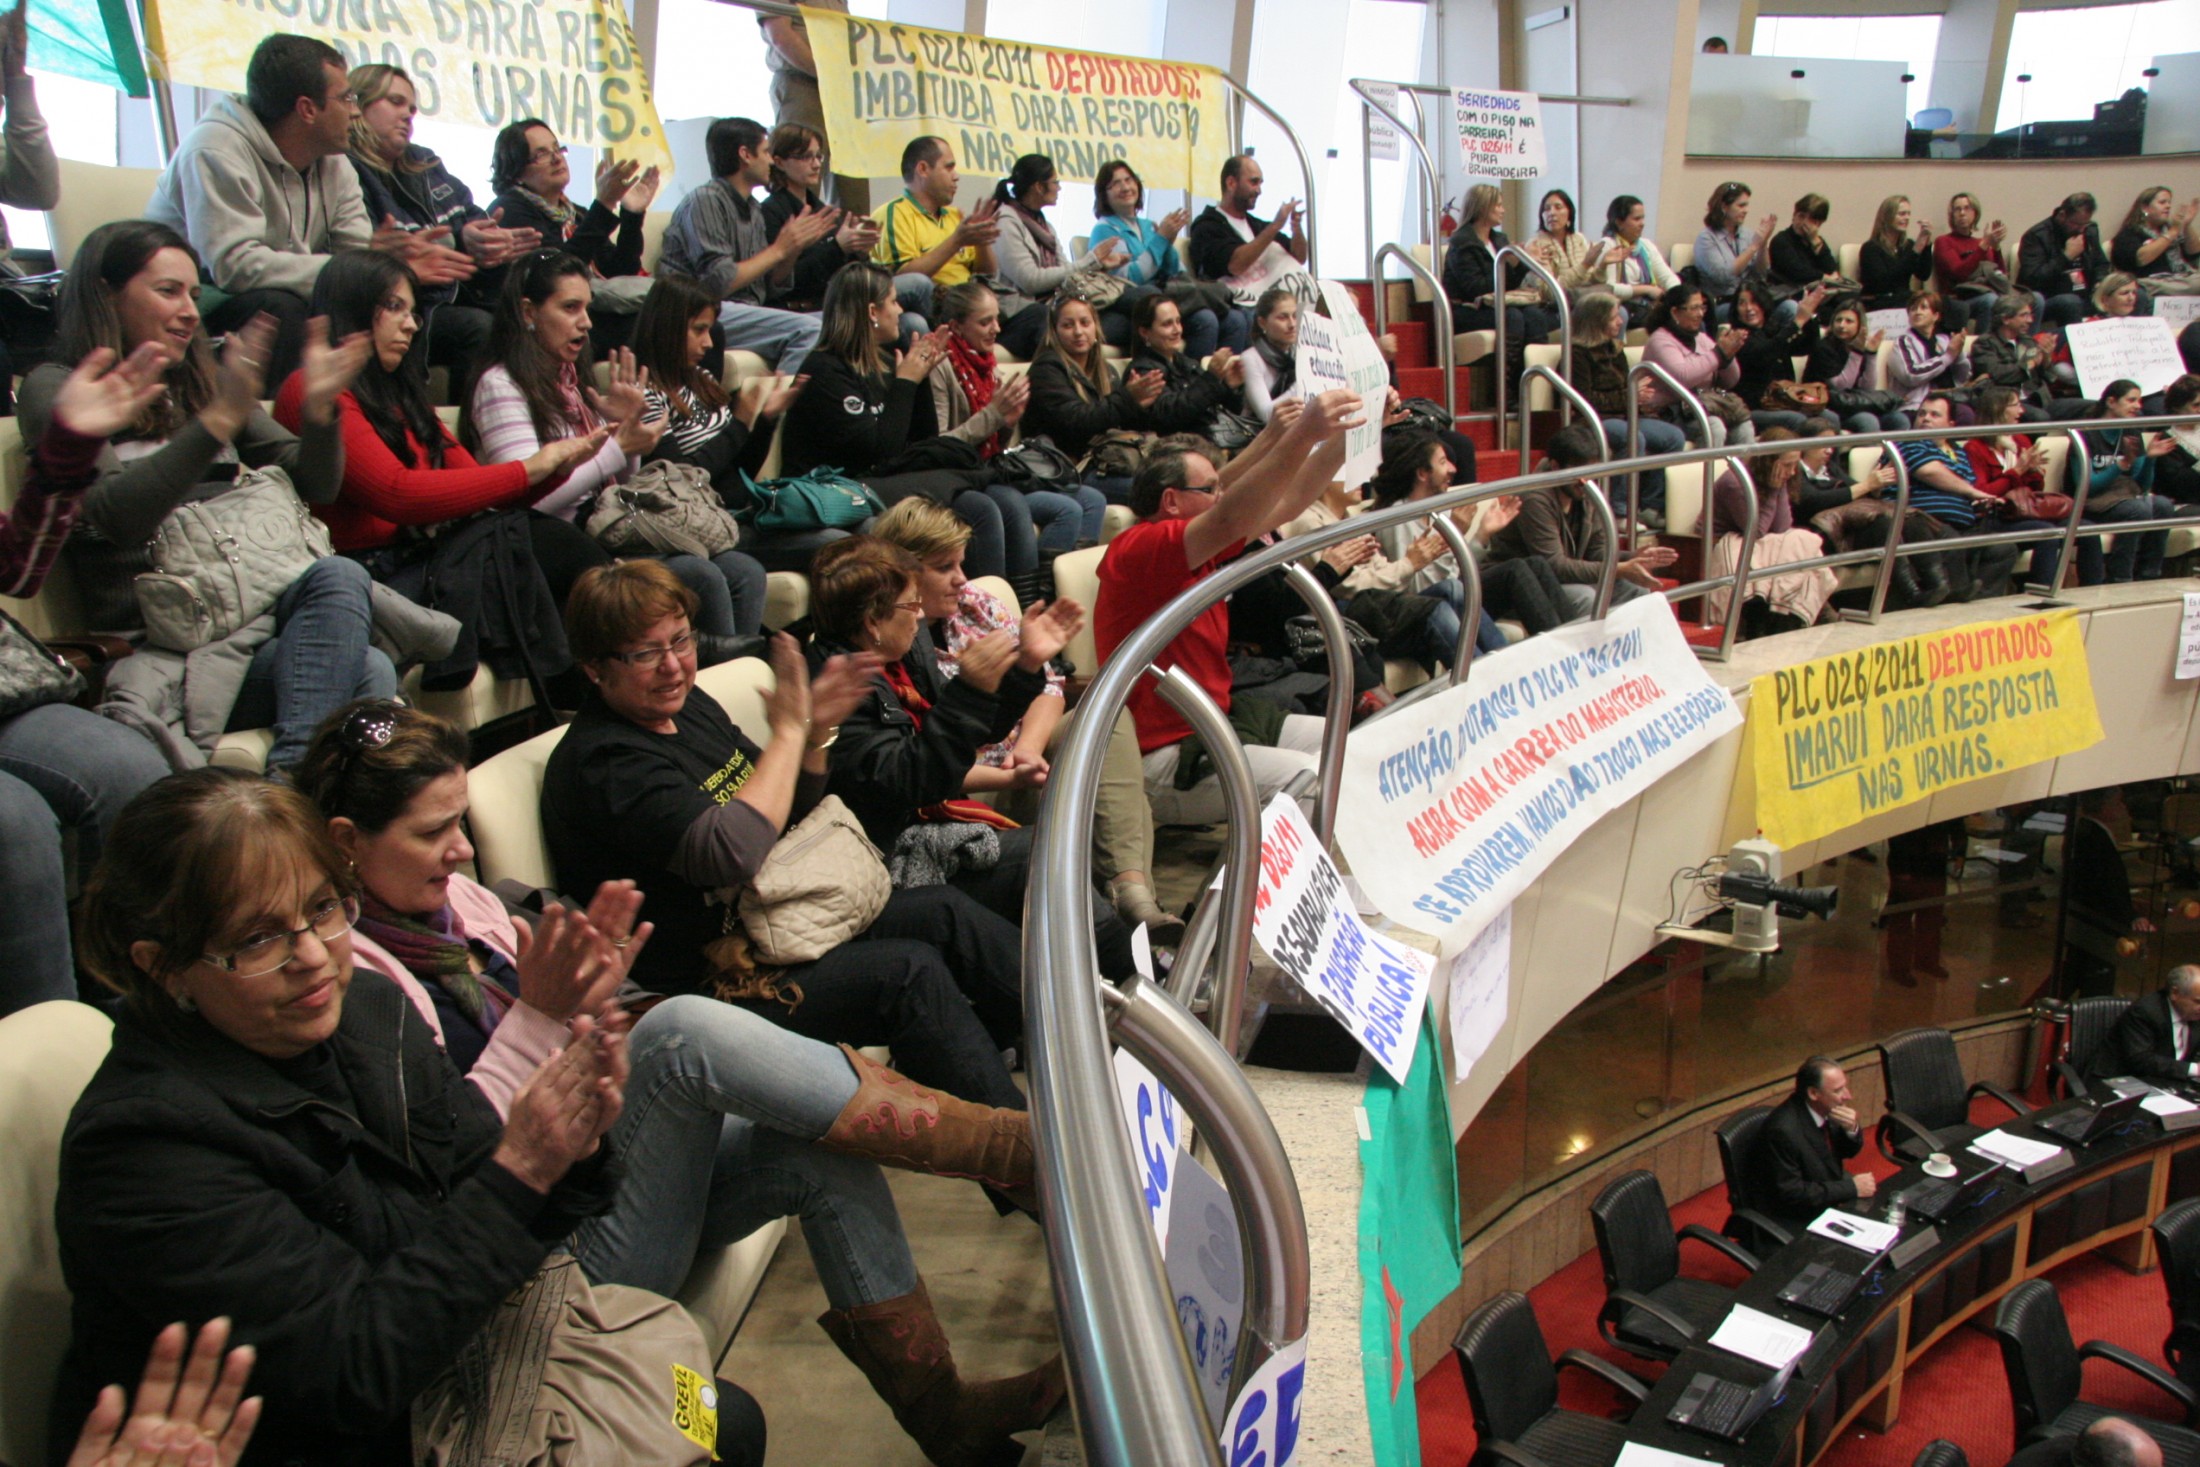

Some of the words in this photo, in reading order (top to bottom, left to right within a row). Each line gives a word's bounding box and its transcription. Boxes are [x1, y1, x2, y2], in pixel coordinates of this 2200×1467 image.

[845, 17, 917, 67] PLC
[917, 31, 1040, 90] 026/2011
[1045, 50, 1202, 100] DEPUTADOS:
[852, 70, 998, 127] IMBITUBA
[1010, 87, 1079, 135] DARÁ
[1081, 97, 1200, 147] RESPOSTA
[1456, 109, 1477, 123] COM
[1481, 112, 1489, 124] O
[1491, 112, 1516, 127] PISO
[1519, 116, 1535, 128] NA
[1457, 90, 1521, 112] SERIEDADE
[960, 128, 1019, 175] NAS
[1460, 137, 1477, 152] PLC
[1481, 140, 1512, 154] 026/11
[1518, 138, 1526, 154] É
[1468, 162, 1538, 178] BRINCADEIRA
[1470, 151, 1498, 164] PURA
[1518, 675, 1536, 709] O
[1532, 662, 1564, 702] PLC
[1774, 662, 1821, 726] PLC
[1825, 638, 1926, 712] 026/2011
[1926, 618, 2054, 681] DEPUTADOS
[1784, 700, 1868, 790] IMARUÍ
[1880, 677, 1936, 754] DARÁ
[1943, 668, 2060, 735] RESPOSTA
[1406, 798, 1467, 859] ACABA
[1450, 776, 1497, 822] COM
[1480, 765, 1509, 798] A
[1555, 711, 1587, 745] DO
[1856, 756, 1905, 814] NAS
[1913, 732, 2005, 792] URNAS.
[1412, 893, 1463, 924] SE
[1515, 777, 1568, 842] VAMOS
[1592, 735, 1643, 787] TROCO
[1636, 717, 1673, 758] NAS
[1272, 853, 1342, 987] DESQUALIFICA
[1319, 906, 1368, 1017] EDUCAÇÃO
